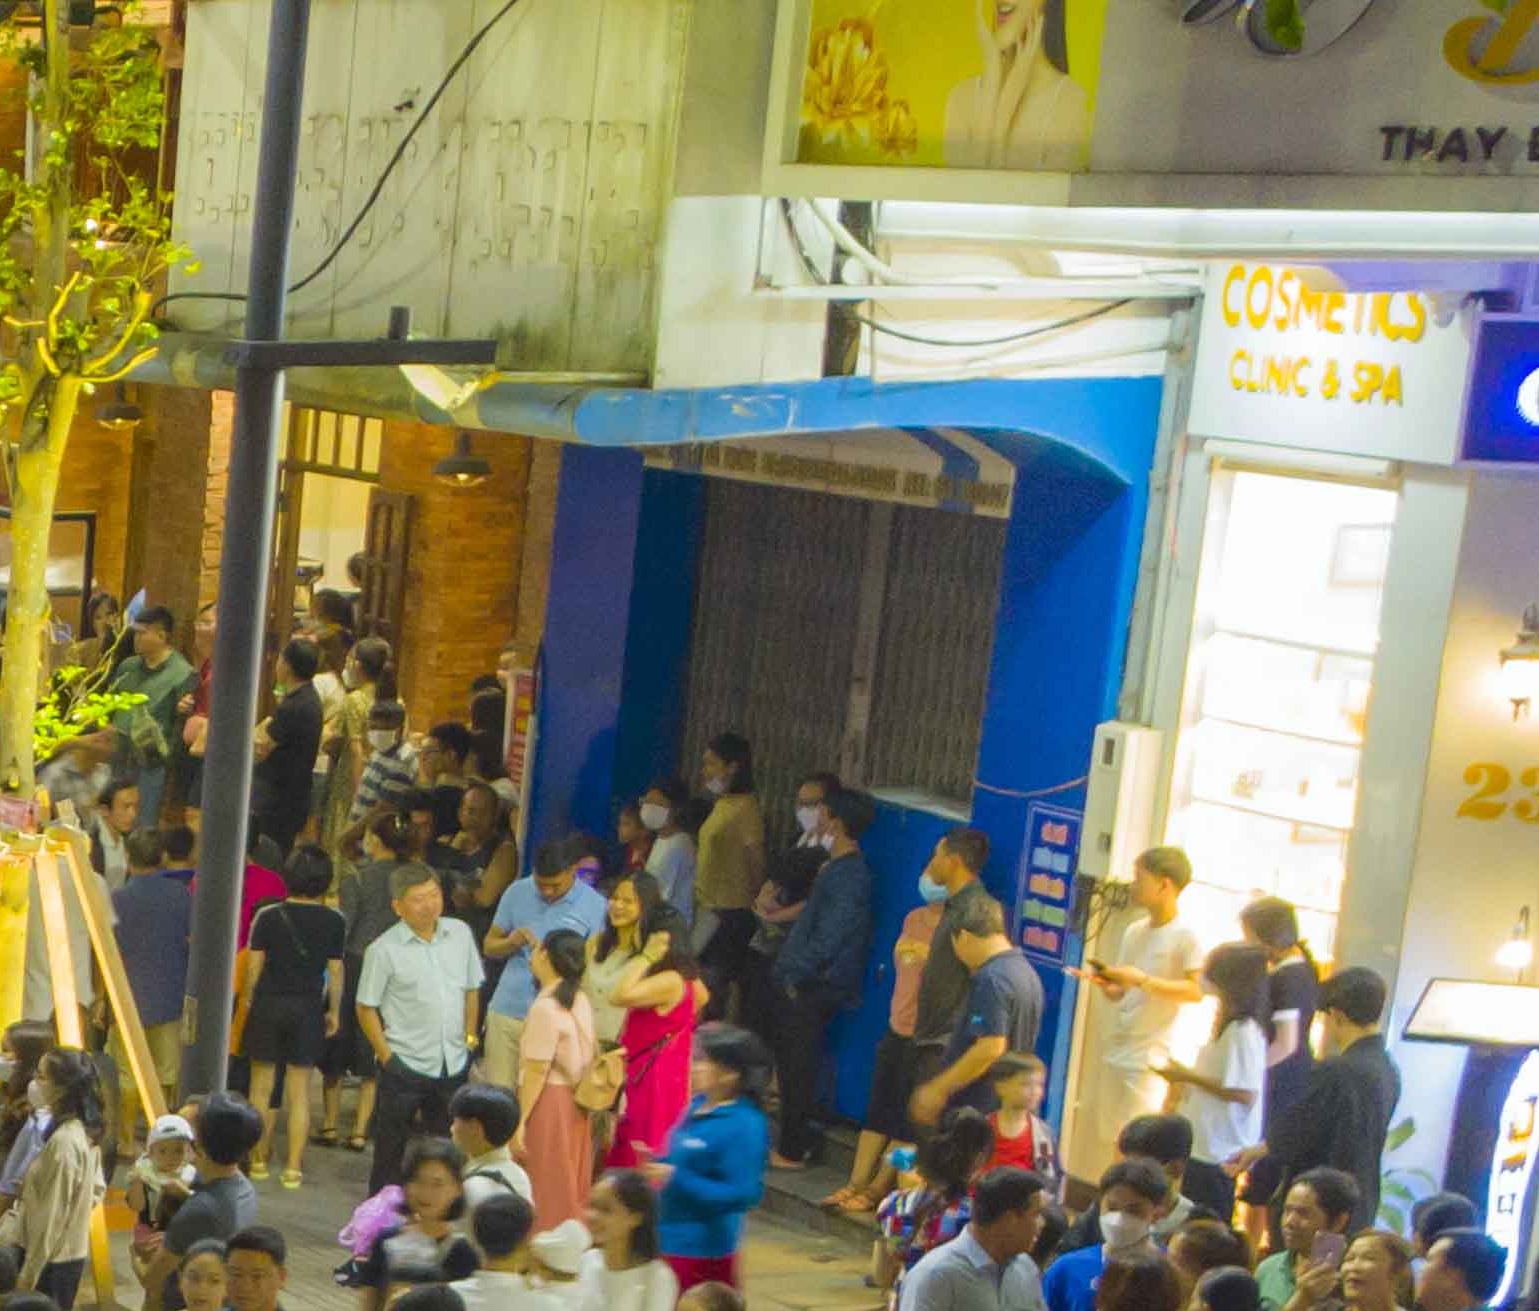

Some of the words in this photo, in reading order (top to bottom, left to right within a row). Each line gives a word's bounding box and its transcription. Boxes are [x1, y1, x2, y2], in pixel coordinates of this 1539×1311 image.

[1380, 125, 1507, 162] THAY
[1229, 347, 1312, 399] CLINIC
[1349, 359, 1404, 407] SPA
